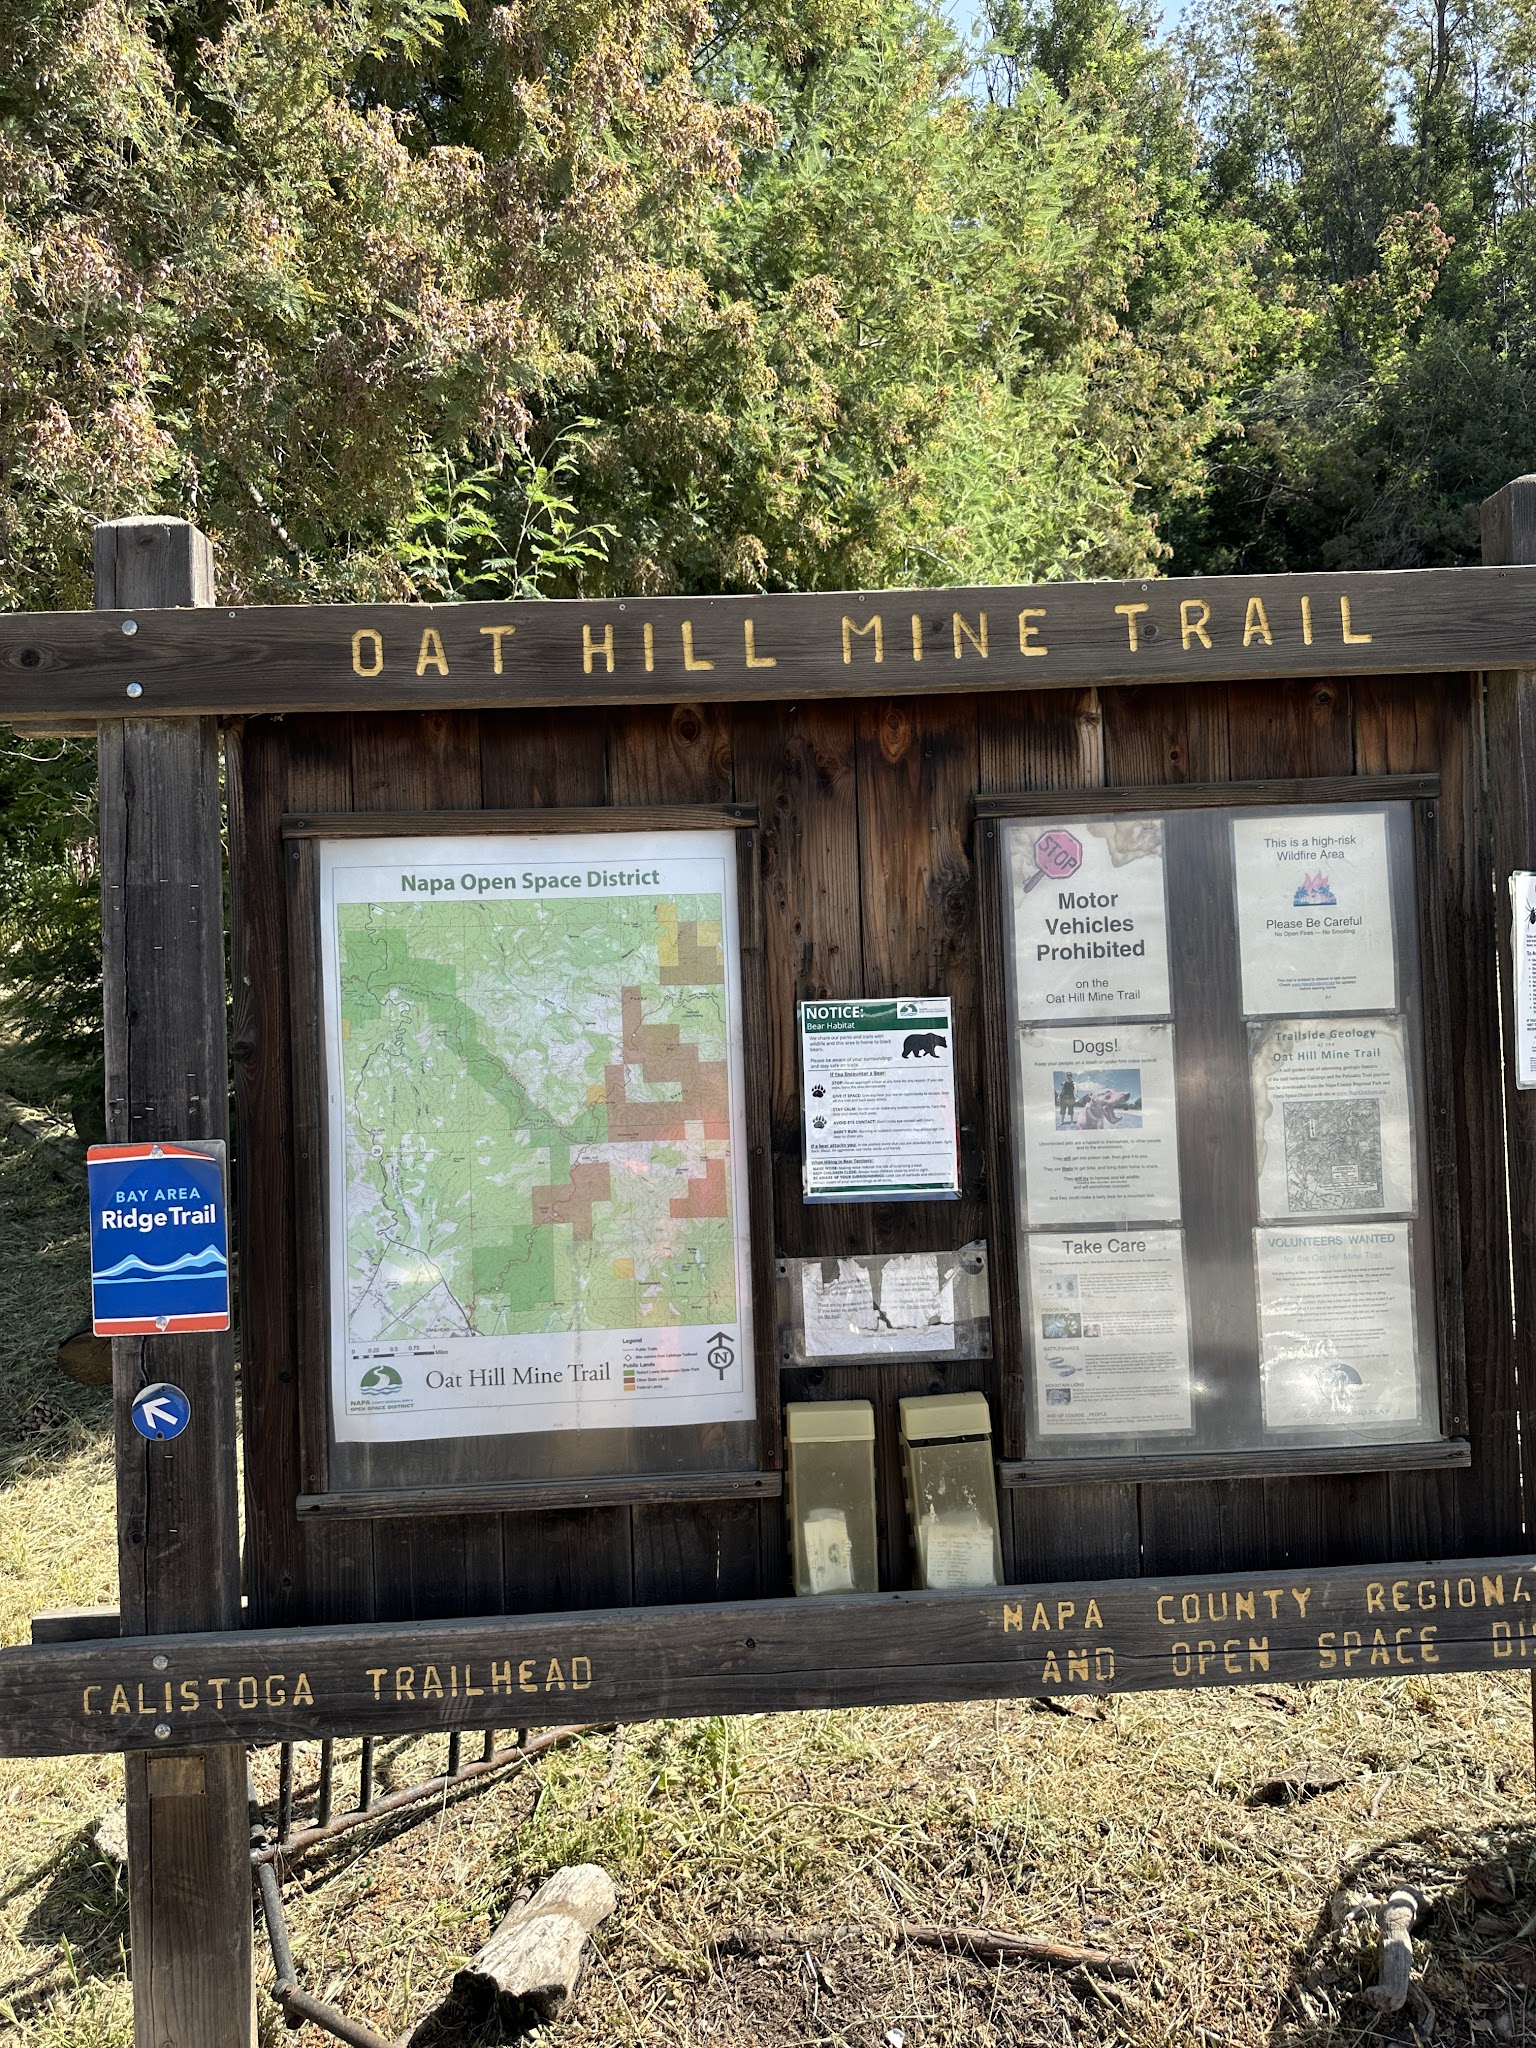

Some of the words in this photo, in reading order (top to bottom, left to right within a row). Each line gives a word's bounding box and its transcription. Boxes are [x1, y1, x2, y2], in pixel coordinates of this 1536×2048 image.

[351, 624, 516, 678] OAT
[581, 616, 777, 675] HILL
[841, 607, 1049, 665] MINE
[1114, 594, 1372, 653] TRAIL
[1264, 838, 1287, 848] This
[1290, 838, 1298, 847] is
[1312, 835, 1356, 848] high-risk
[1038, 836, 1077, 871] STOP
[1277, 850, 1316, 861] Wildfire
[1320, 850, 1344, 859] Area
[401, 874, 456, 895] Napa
[460, 872, 516, 894] Open
[521, 872, 582, 892] Space
[586, 869, 660, 888] District
[1059, 892, 1118, 909] Motor
[1045, 916, 1134, 935] Vehicles
[1266, 919, 1302, 929] Please
[1306, 918, 1320, 928] Be
[1324, 916, 1362, 927] Careful
[1037, 940, 1144, 961] Prohibited
[1076, 981, 1089, 989] on
[1092, 979, 1109, 988] the
[1046, 994, 1065, 1004] Oat
[1069, 993, 1084, 1002] Hill
[1089, 992, 1113, 1001] Mine
[1117, 990, 1140, 1000] Trail
[806, 1006, 864, 1019] NOTICE:
[807, 1022, 824, 1030] Bear
[1276, 1030, 1325, 1042] Trailside
[1330, 1029, 1376, 1042] Geology
[1073, 1038, 1118, 1056] Dogs!
[1273, 1052, 1293, 1062] Oat
[1298, 1050, 1317, 1060] Hill
[1321, 1050, 1350, 1060] Mine
[1354, 1048, 1381, 1058] Trail
[116, 1190, 149, 1203] BAY
[154, 1187, 201, 1200] AREA
[102, 1208, 168, 1233] Ridge
[168, 1204, 216, 1225] Trail
[1062, 1240, 1103, 1254] Take
[1108, 1239, 1146, 1253] Care
[1268, 1236, 1342, 1248] VOLUNTEERS
[1348, 1234, 1395, 1244] WANTED
[714, 1352, 728, 1364] N
[426, 1371, 462, 1388] Oat
[469, 1367, 506, 1386] Hill
[513, 1367, 563, 1384] Mine
[567, 1362, 611, 1382] Trail
[1003, 1598, 1104, 1633] NAPA
[1156, 1586, 1312, 1625] COUNTY
[1042, 1646, 1116, 1684] AND
[1171, 1635, 1270, 1678] OPEN
[1317, 1624, 1440, 1669] SPACE
[1491, 1621, 1536, 1660] DI
[82, 1672, 314, 1716] CALISTOGA
[365, 1655, 593, 1702] TRAILHEAD
